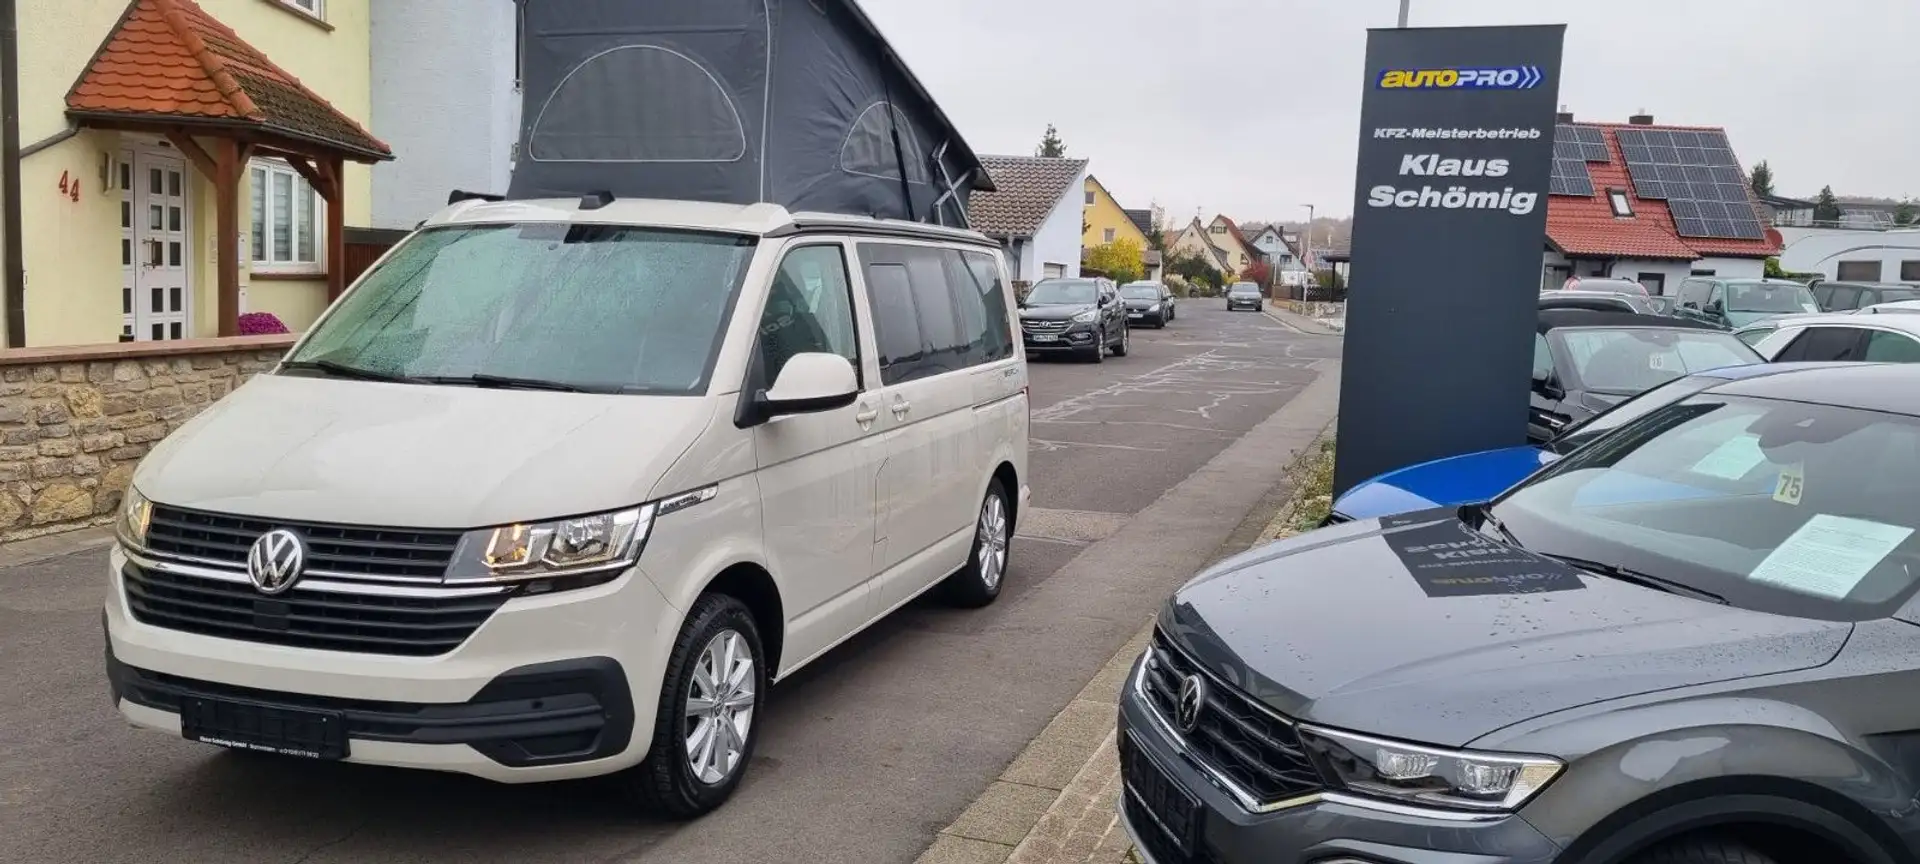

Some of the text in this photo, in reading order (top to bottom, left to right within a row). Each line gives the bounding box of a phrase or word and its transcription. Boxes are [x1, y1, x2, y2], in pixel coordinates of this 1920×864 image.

[1374, 128, 1540, 139] KFZ-Meisterbetrieb
[1399, 154, 1509, 177] Klaus
[59, 170, 79, 202] 44
[1368, 185, 1538, 214] Schömig
[1779, 474, 1801, 498] 75
